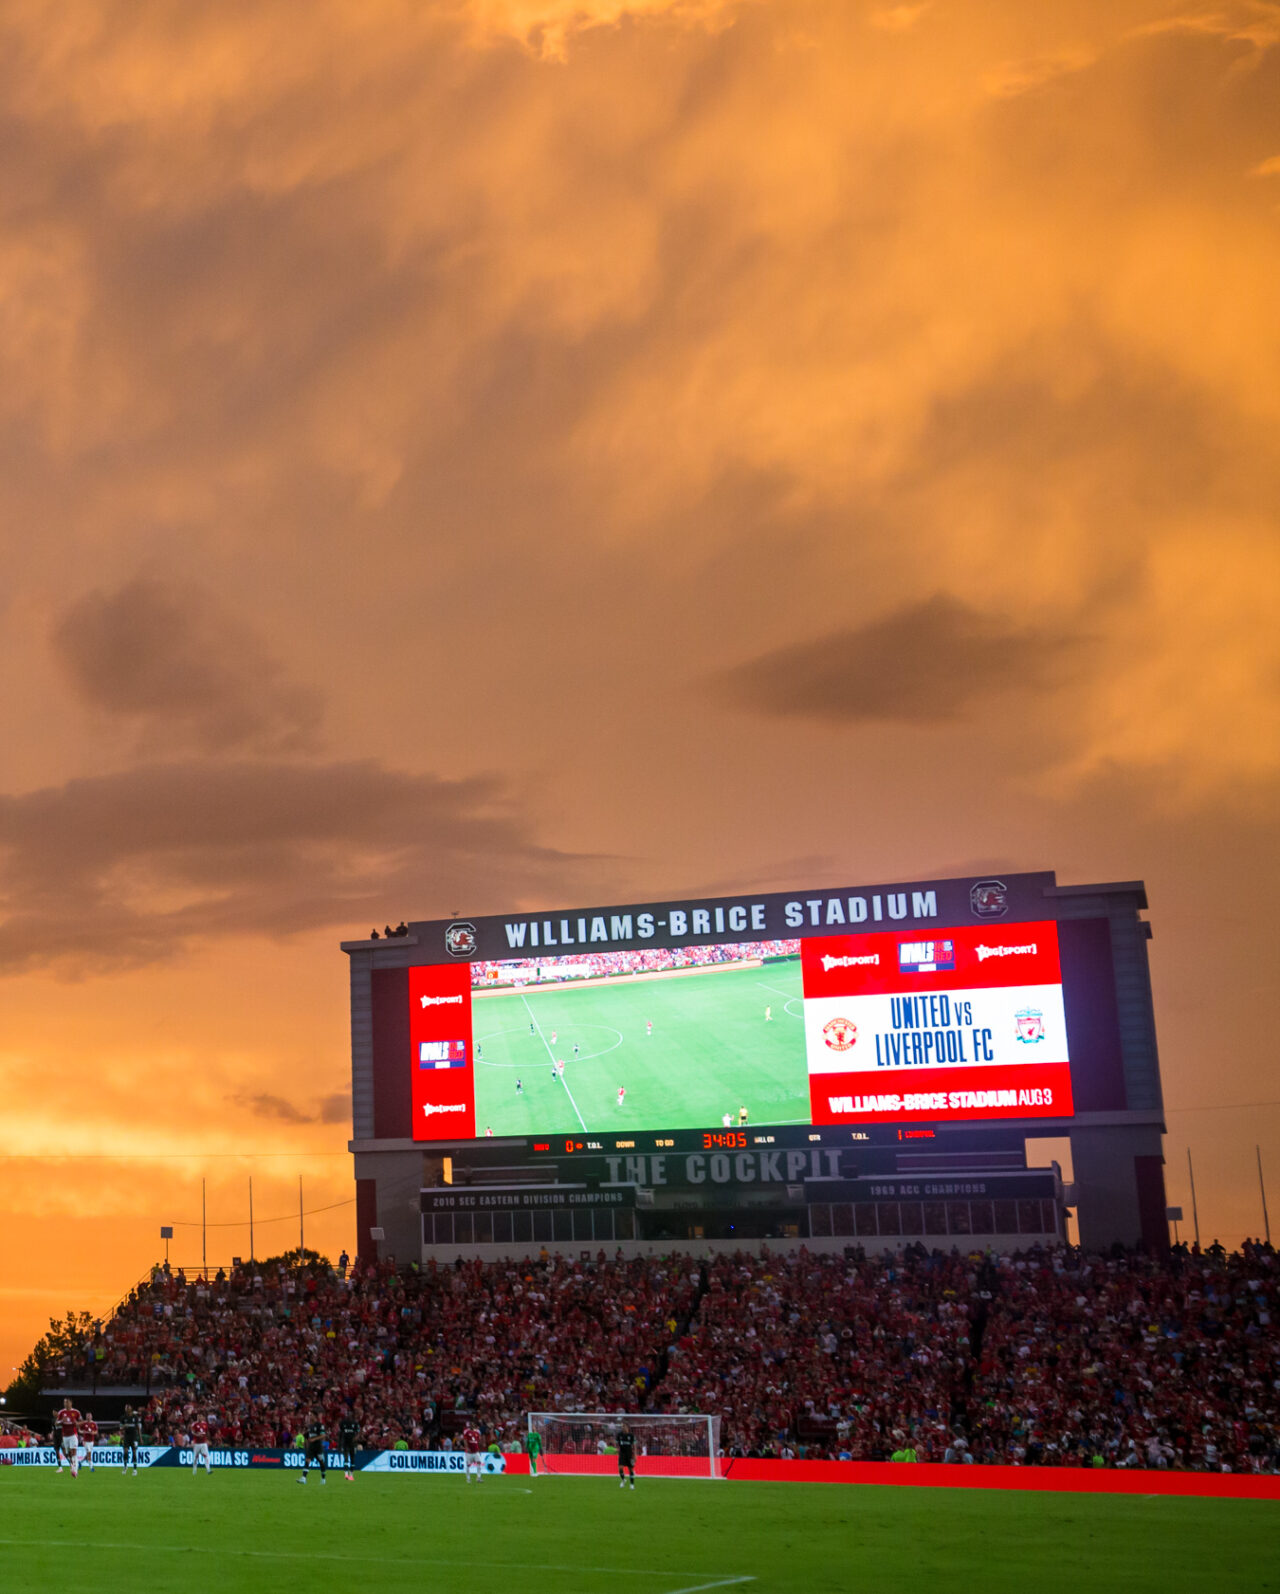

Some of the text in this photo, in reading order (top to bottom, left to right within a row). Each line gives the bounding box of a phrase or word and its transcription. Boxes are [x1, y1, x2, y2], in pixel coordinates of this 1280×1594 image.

[505, 891, 937, 948] WILLIAMS-BRICE STADIUM
[890, 994, 972, 1029] UNITED VS
[875, 1028, 994, 1066] LIVERPOOL FC
[828, 1088, 1053, 1114] WILLIAMS-BRICE STADIUM AUG 3
[703, 1132, 747, 1149] 34:05
[606, 1149, 843, 1186] THE COCKPIT
[924, 1183, 987, 1195] CHAMPIONS
[459, 1197, 476, 1206] SEC
[479, 1195, 519, 1206] EASTERN
[523, 1194, 565, 1205] DIVISION
[570, 1192, 623, 1203] CHAMPIONS
[43, 1452, 57, 1464] SC
[91, 1451, 122, 1464] OCCER
[234, 1452, 248, 1466] SC
[389, 1455, 464, 1470] COLUMBIA SC
